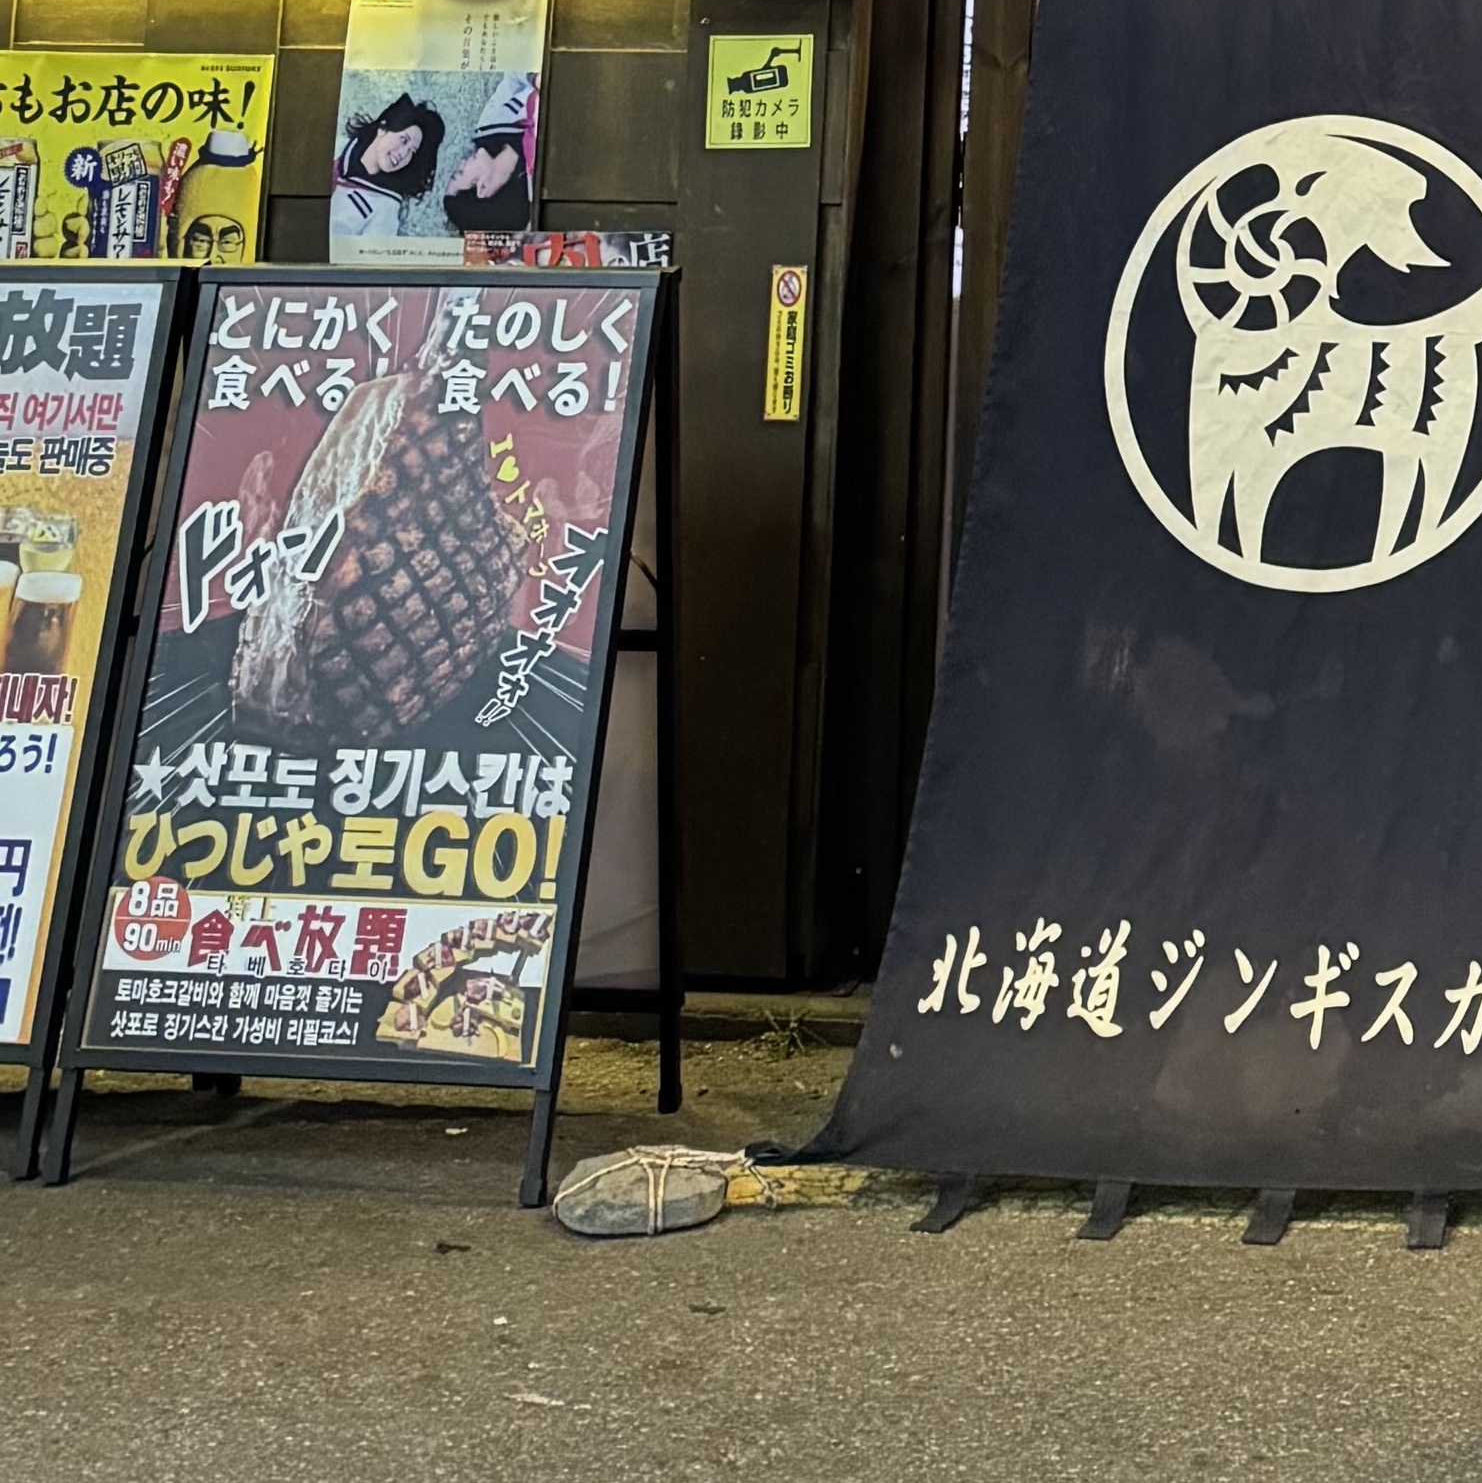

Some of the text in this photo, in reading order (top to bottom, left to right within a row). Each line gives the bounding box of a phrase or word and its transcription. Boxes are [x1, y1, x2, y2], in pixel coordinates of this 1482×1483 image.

[722, 99, 799, 118] 防犯カメラ
[71, 155, 98, 182] 新
[0, 288, 143, 381] 放題
[215, 296, 399, 353] とにかく
[446, 299, 633, 354] たのしく
[437, 360, 621, 415] 食べる!
[23, 392, 123, 431] 여기서만
[40, 437, 115, 476] 판매중
[127, 881, 180, 918] 8品
[122, 922, 181, 954] 90min
[188, 905, 407, 977] 食べ放題
[229, 983, 259, 1009] 함께
[316, 986, 363, 1015] 즐기는
[111, 1013, 358, 1046] 삿포로 징기스칸 가성비 리필코스!
